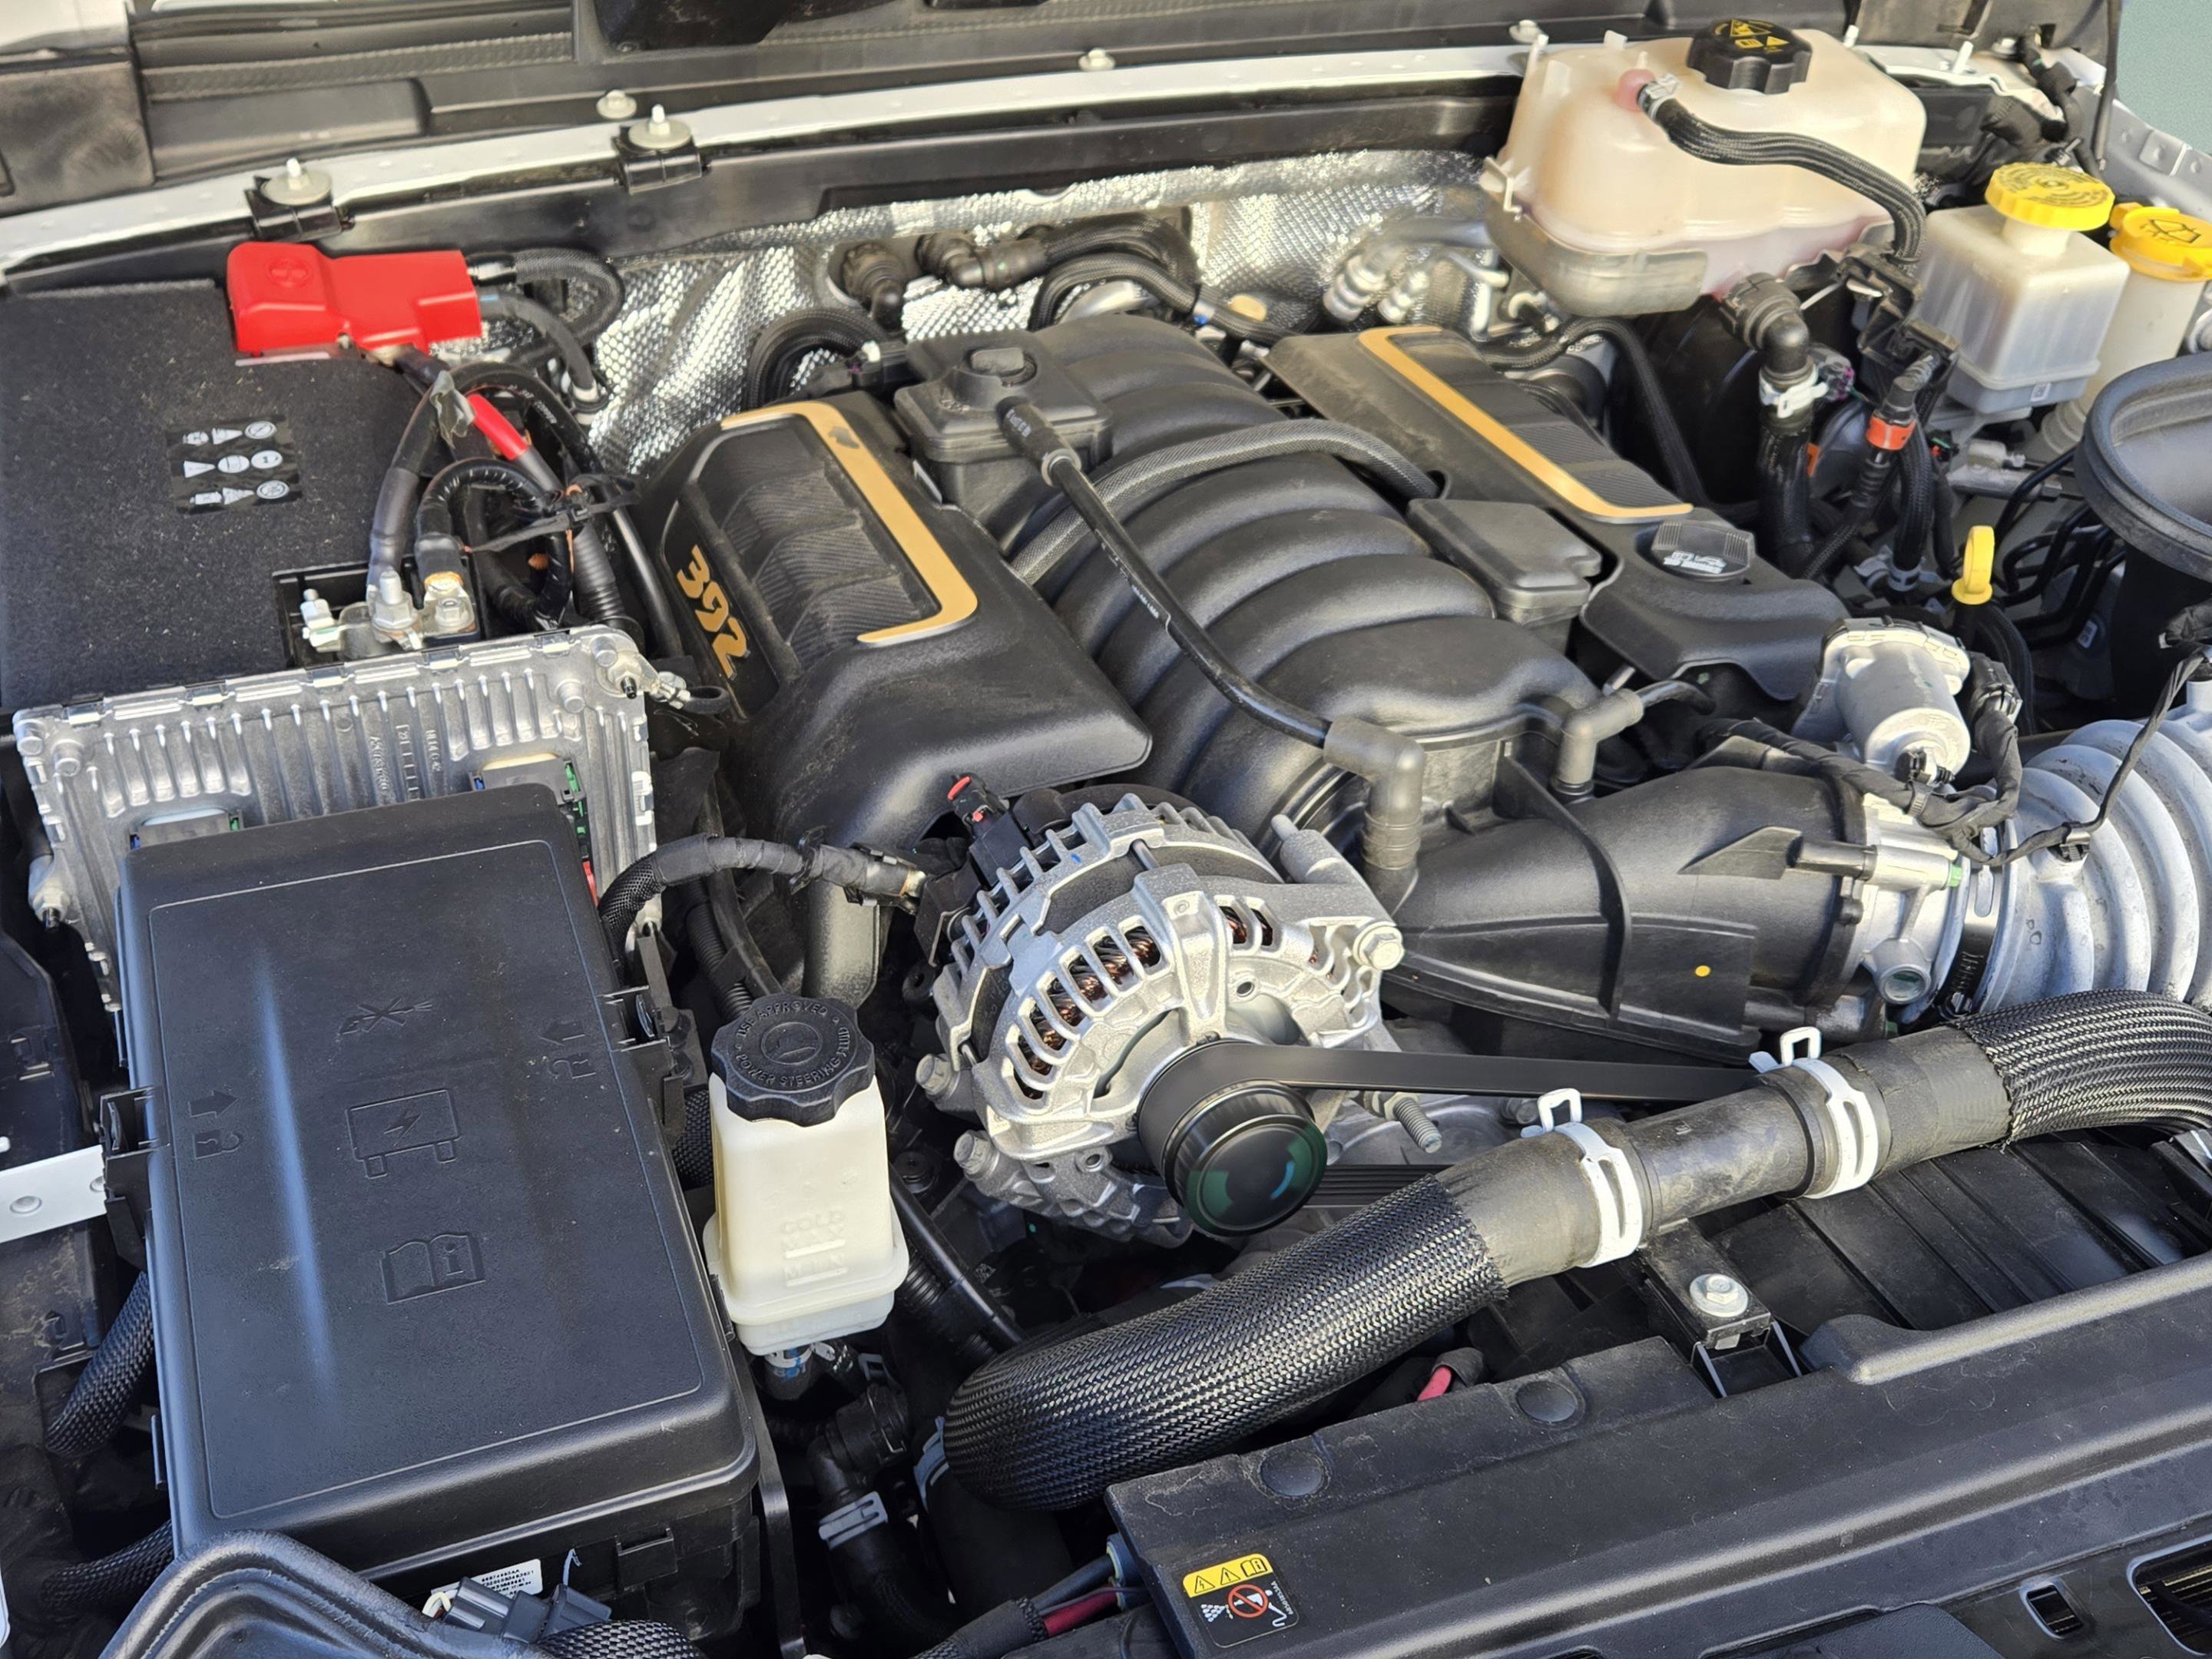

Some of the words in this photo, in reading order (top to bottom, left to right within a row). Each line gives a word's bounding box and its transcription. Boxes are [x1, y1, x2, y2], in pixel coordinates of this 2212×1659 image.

[677, 545, 748, 680] 392
[737, 1018, 756, 1038] USE
[757, 1001, 828, 1019] APPROVED
[737, 1054, 775, 1084] POWER
[780, 1057, 840, 1087] STEERING
[781, 1210, 847, 1234] COLD
